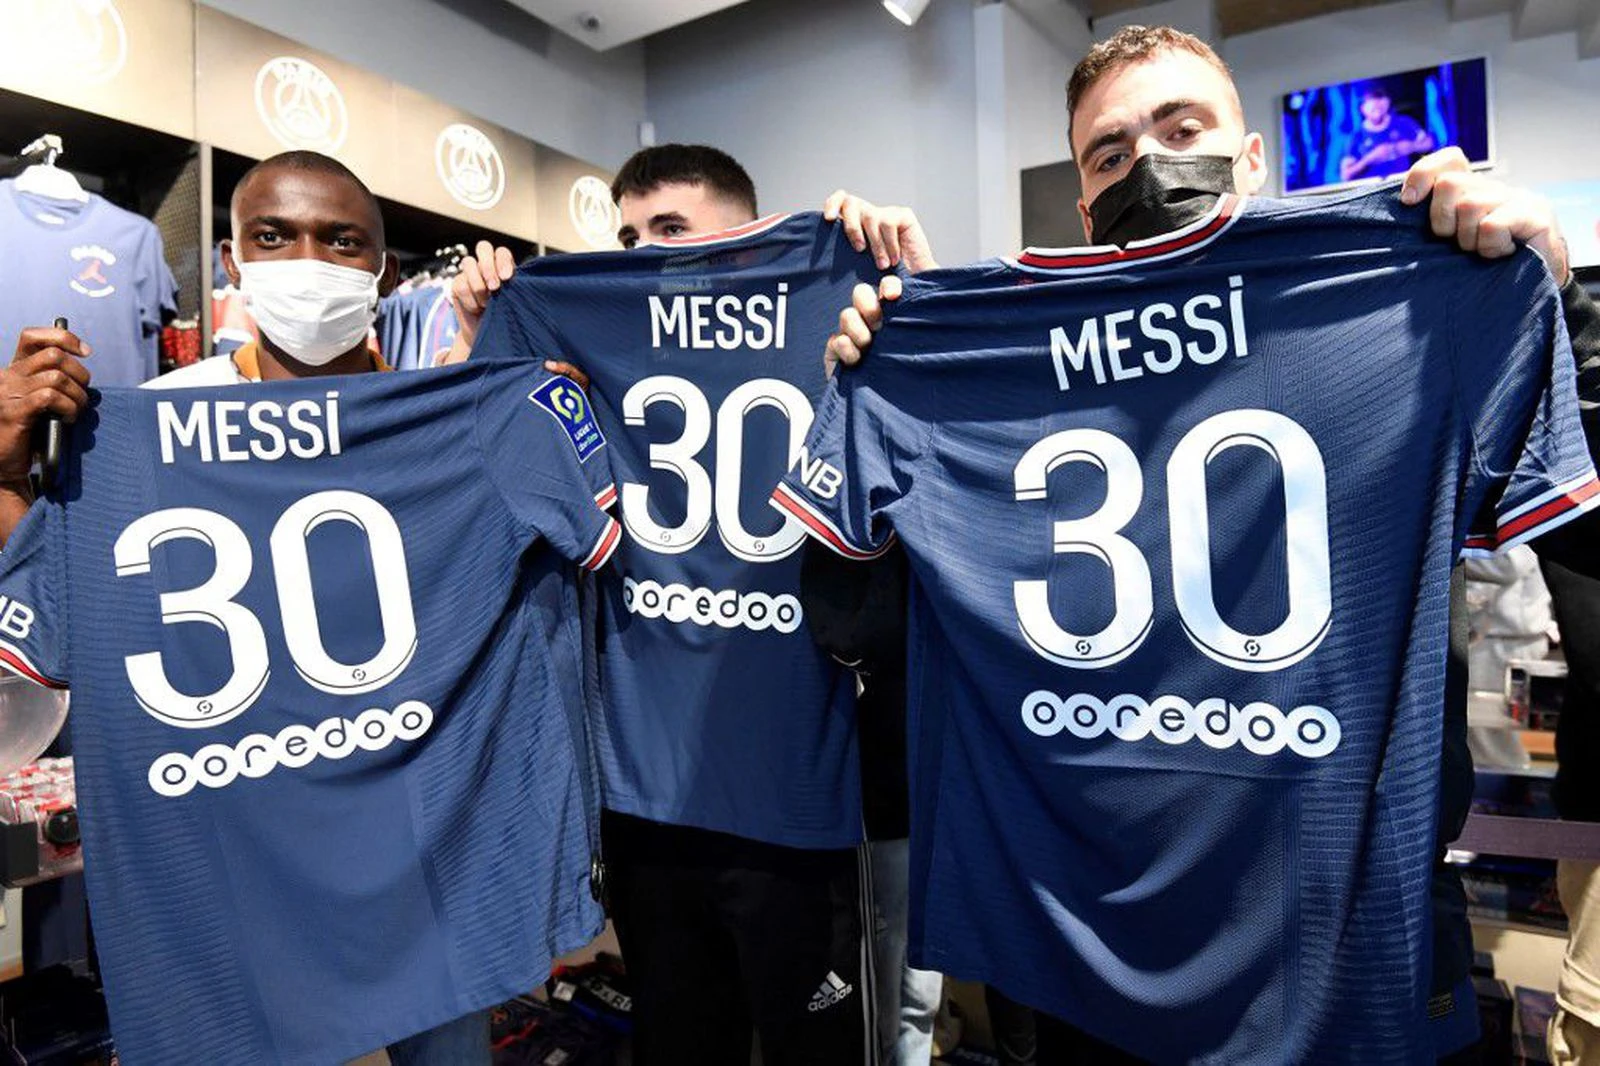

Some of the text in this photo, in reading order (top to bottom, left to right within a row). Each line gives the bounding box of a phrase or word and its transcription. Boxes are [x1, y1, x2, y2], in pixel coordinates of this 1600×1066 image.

[622, 375, 814, 562] 30
[1013, 409, 1333, 673] 30
[114, 490, 419, 729] 30
[154, 704, 428, 791] ooredoo
[1026, 695, 1335, 752] ooredoo
